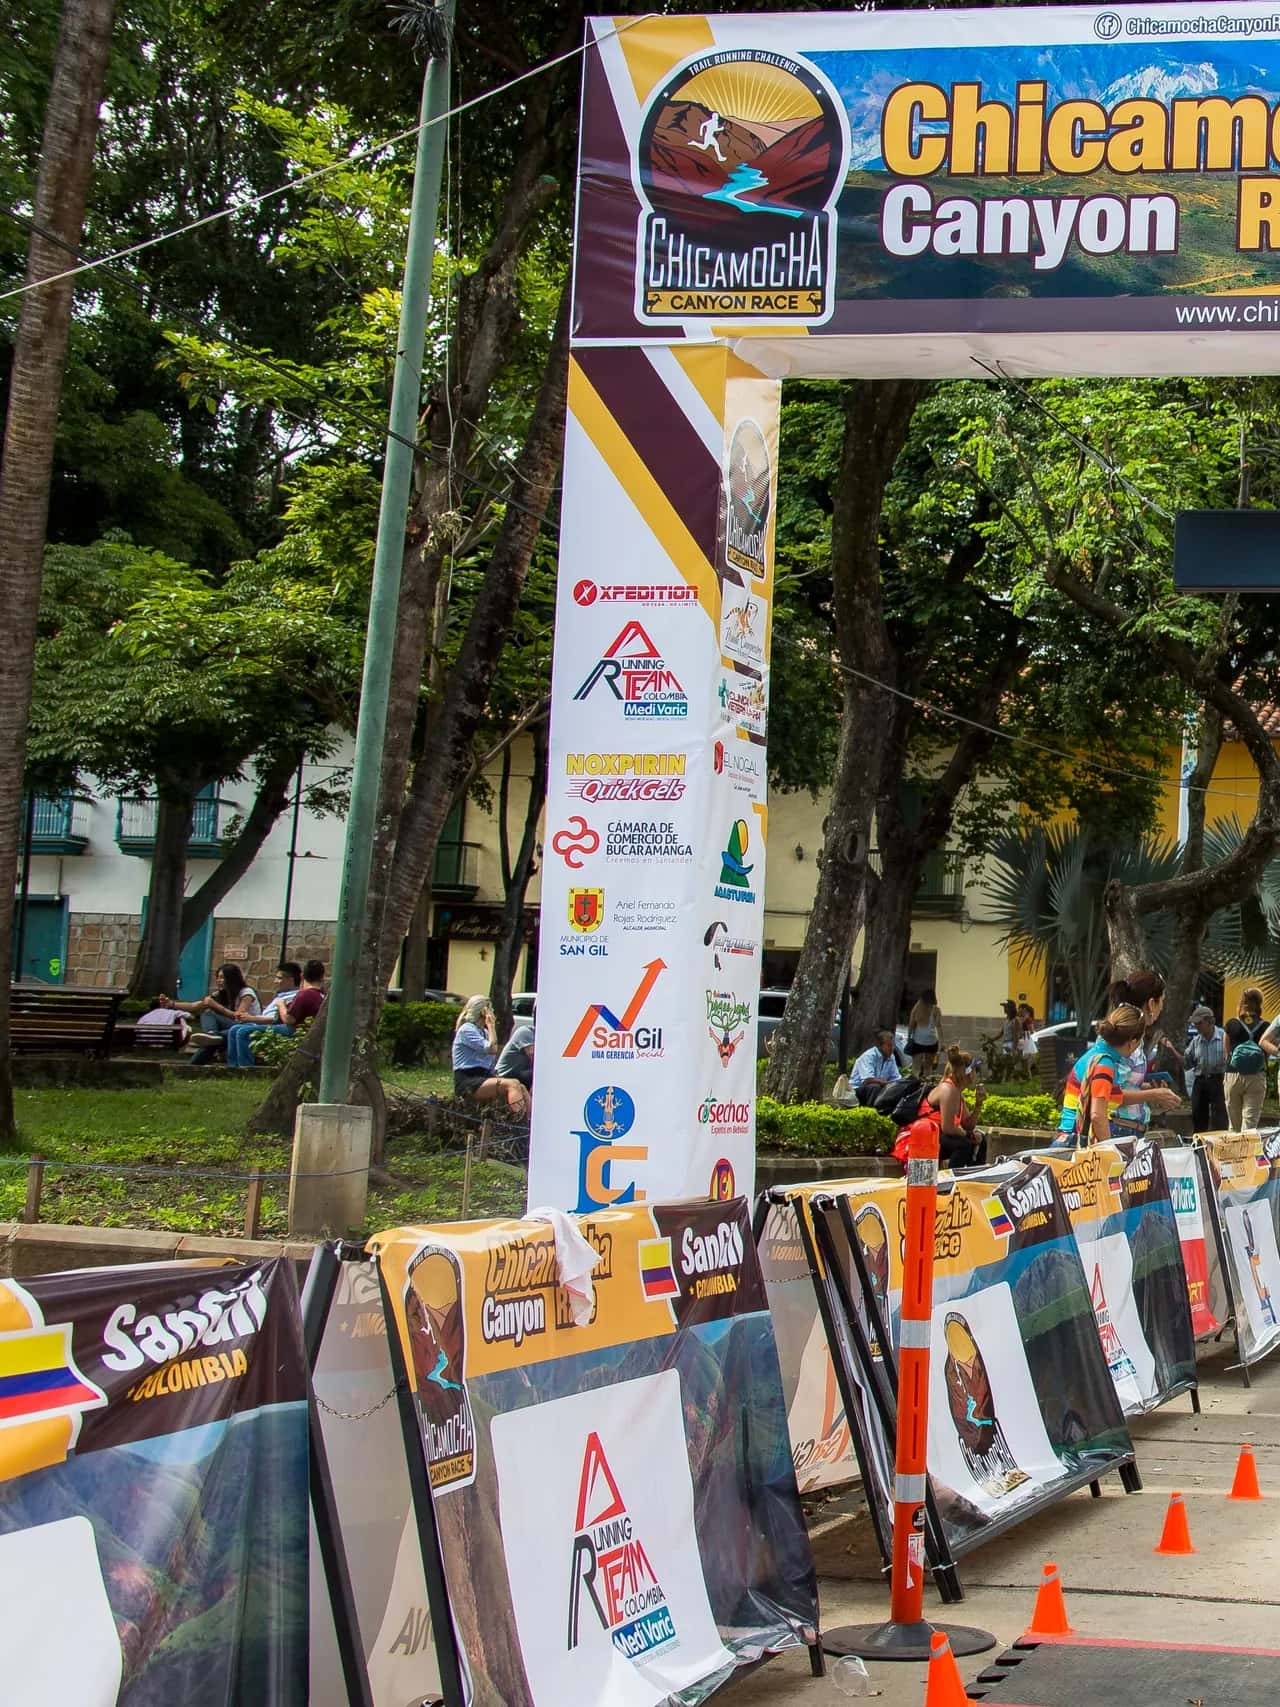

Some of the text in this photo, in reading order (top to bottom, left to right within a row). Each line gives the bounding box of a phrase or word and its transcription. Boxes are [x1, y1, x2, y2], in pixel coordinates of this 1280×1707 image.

[688, 51, 800, 76] TRAIL RUNNING CHALLENGE
[881, 183, 1179, 272] Canyon
[649, 216, 822, 288] CHICAMOCHA
[670, 295, 799, 310] CANYON RACE
[600, 585, 698, 600] XPEDITION
[622, 671, 684, 700] TEAM
[567, 753, 686, 776] NOXPIRIN
[581, 779, 686, 803] QuickGels
[608, 820, 674, 833] CÁMARA DE
[607, 834, 678, 844] COMERCIO DE
[606, 845, 692, 855] BUCARAMANGA
[638, 900, 675, 910] Fernando
[614, 914, 634, 924] Rojas
[560, 945, 608, 955] SAN GIL
[592, 1026, 662, 1049] SanGil
[606, 1051, 634, 1059] GERENCIA
[636, 1048, 664, 1058] Social
[482, 1293, 545, 1347] Canyon
[451, 1459, 465, 1474] RACE
[598, 1540, 658, 1627] TEAM
[624, 1585, 666, 1617] COLOMBIA
